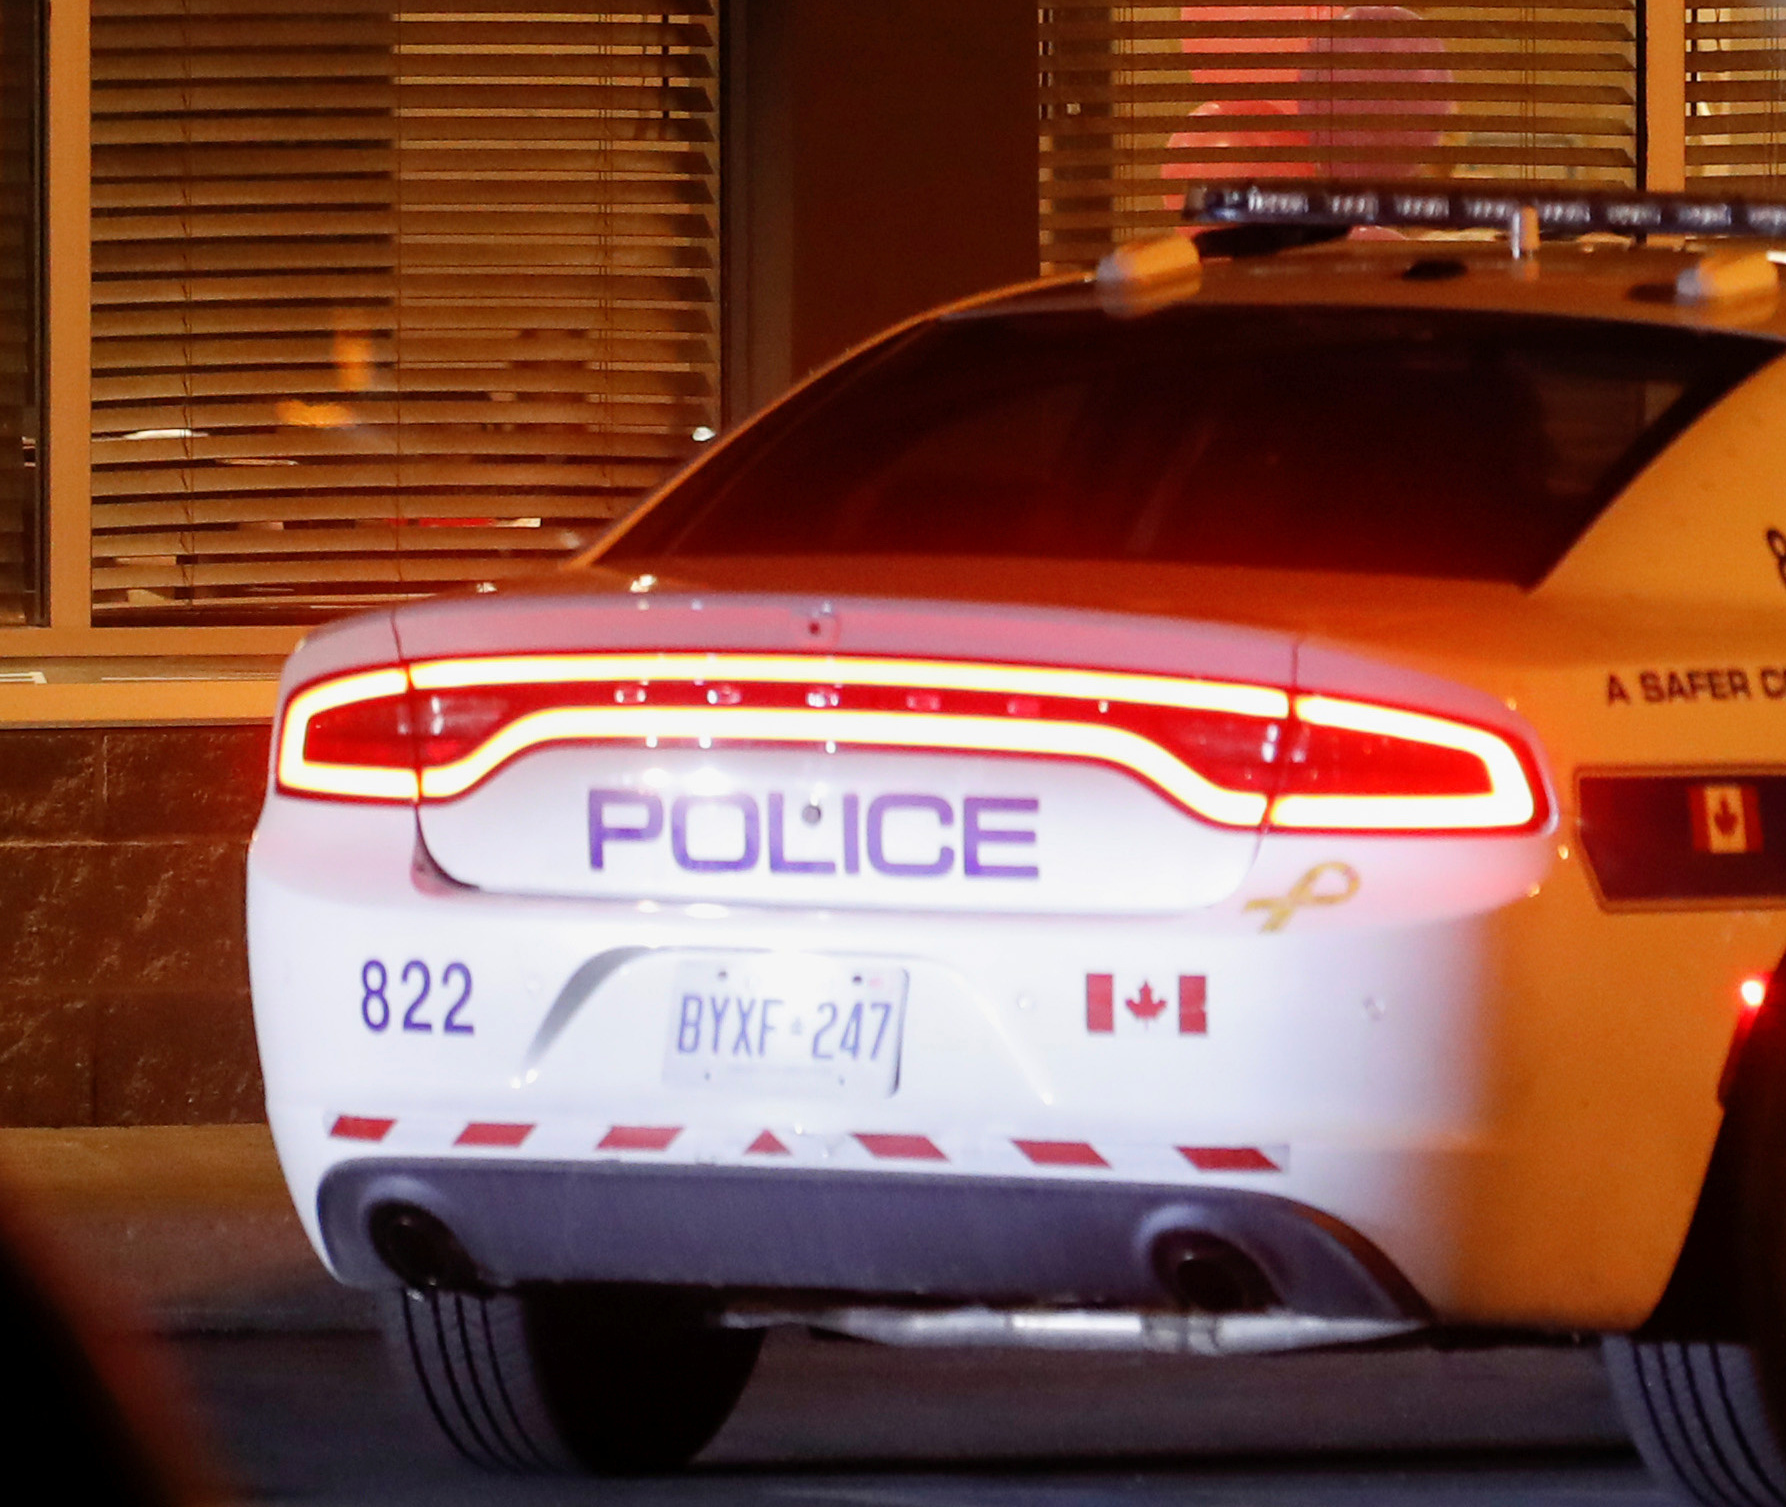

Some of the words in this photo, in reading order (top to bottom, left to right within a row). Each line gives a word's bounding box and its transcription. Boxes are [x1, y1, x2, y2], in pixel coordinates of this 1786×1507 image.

[1605, 674, 1632, 707] A
[1639, 667, 1751, 704] SAFER
[587, 788, 1039, 880] POLICE
[359, 958, 476, 1035] 822
[677, 993, 784, 1057] BYXF
[811, 1000, 893, 1061] 247
